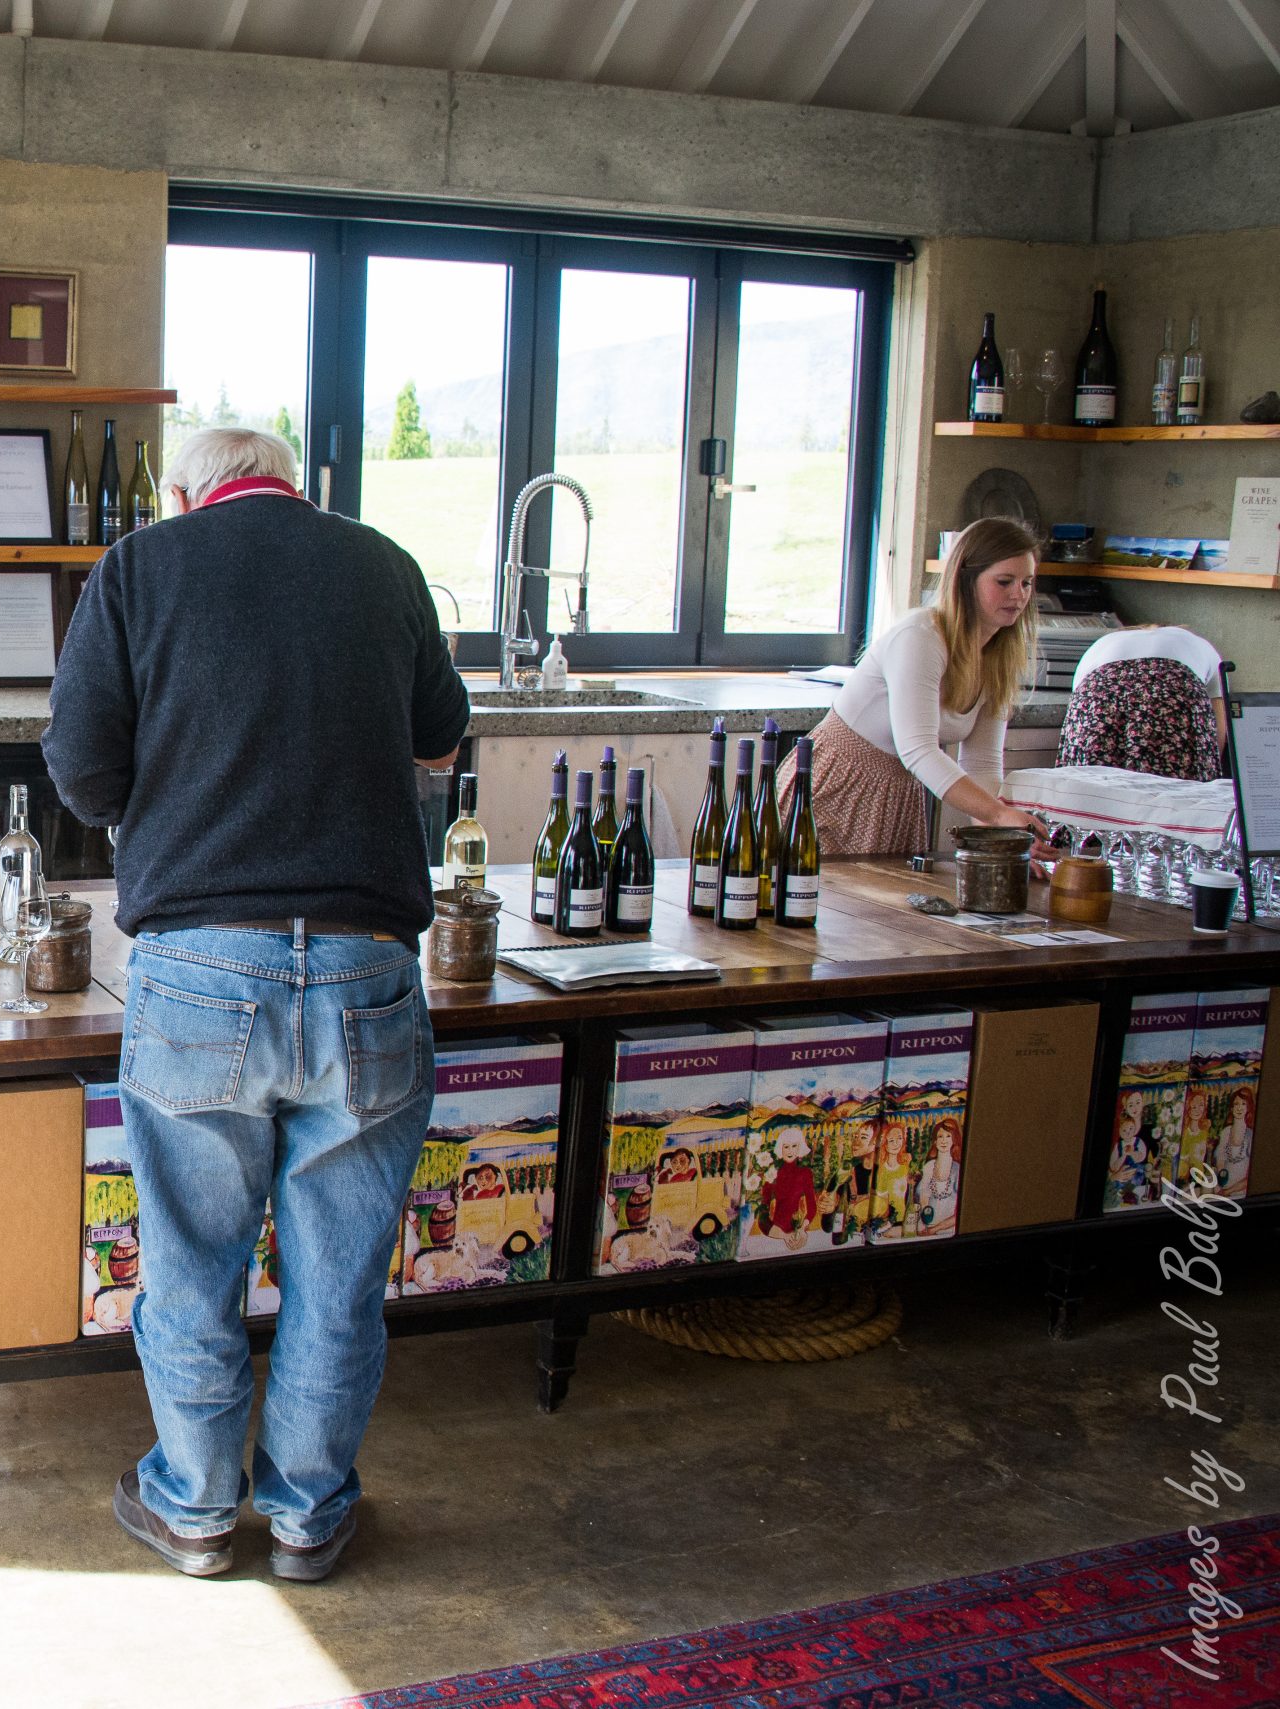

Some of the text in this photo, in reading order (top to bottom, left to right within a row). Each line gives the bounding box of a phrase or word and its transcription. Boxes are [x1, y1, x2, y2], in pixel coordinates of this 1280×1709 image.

[1251, 487, 1272, 495] WINE
[1241, 496, 1278, 505] GRAPES
[1129, 1013, 1188, 1026] RIPPON
[1205, 1009, 1261, 1022] RIPPON
[900, 1034, 964, 1049] RIPPON
[791, 1045, 857, 1061] RIPPON
[649, 1055, 719, 1071] RIPPON
[447, 1068, 525, 1085] RIPPON
[93, 1229, 124, 1239] RIPPON
